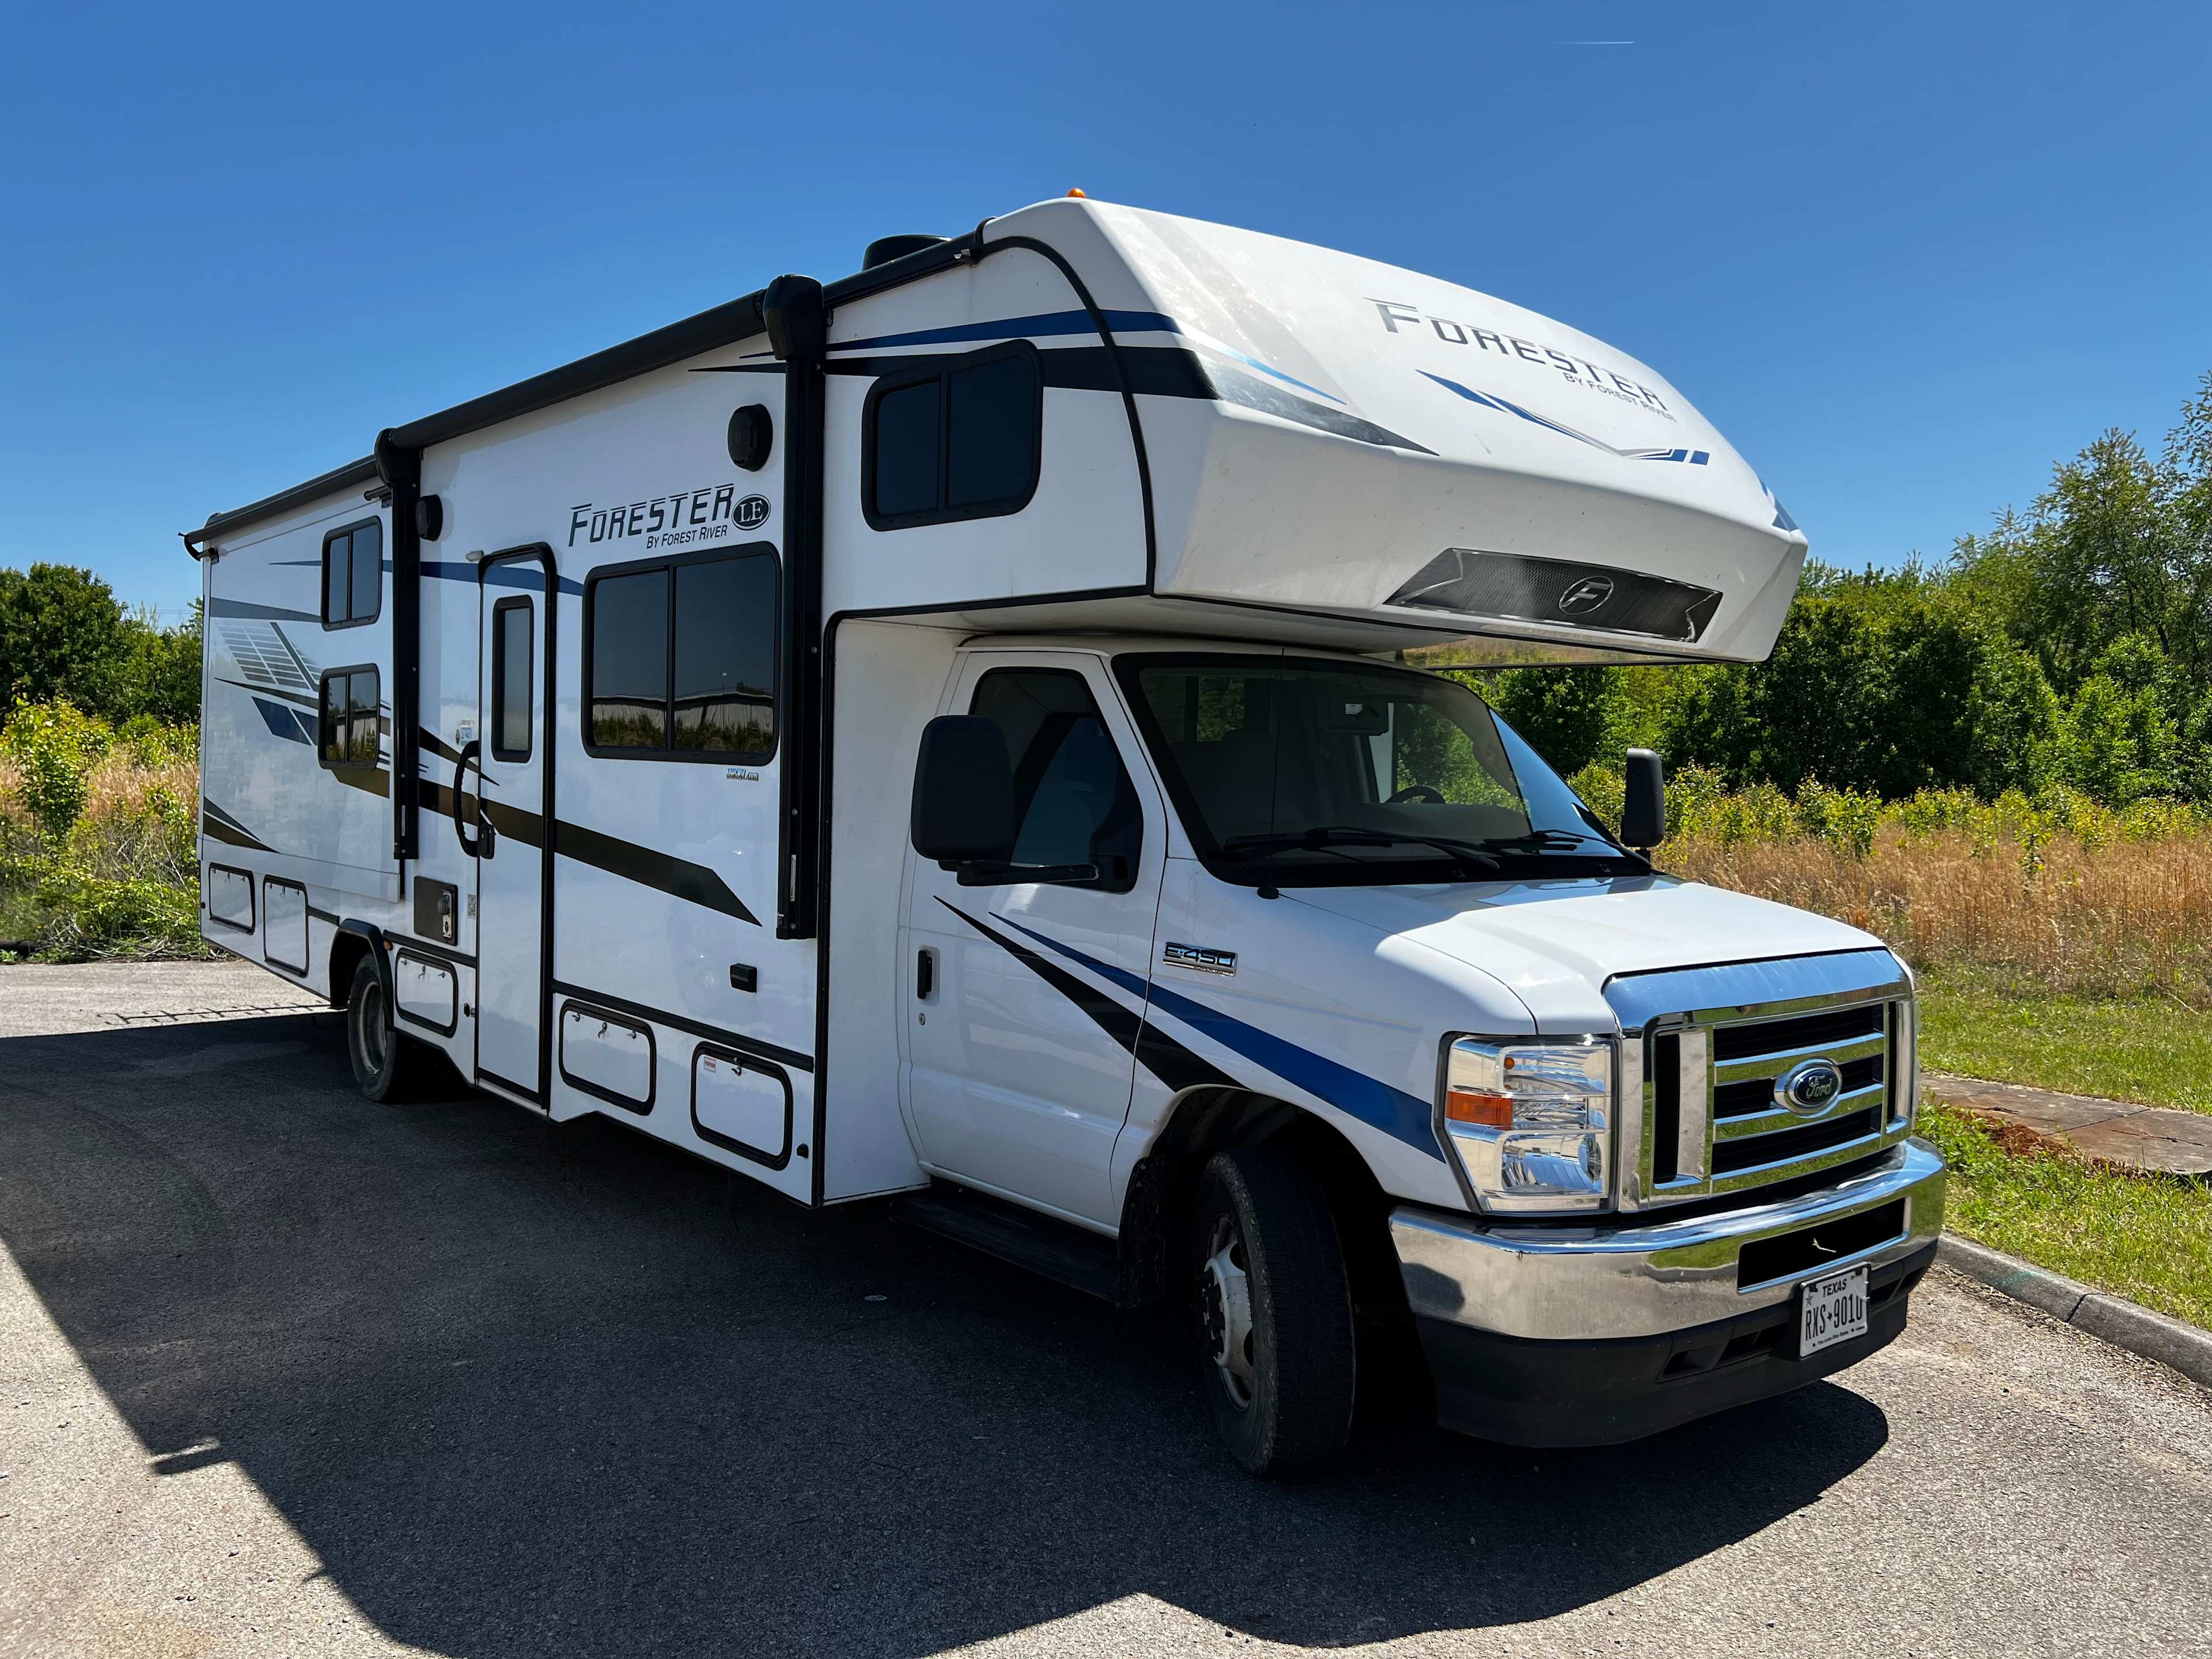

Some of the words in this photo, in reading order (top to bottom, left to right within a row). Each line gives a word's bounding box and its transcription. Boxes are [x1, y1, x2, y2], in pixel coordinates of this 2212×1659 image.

[1363, 297, 1668, 411] FORESTER
[1563, 372, 1583, 385] BY
[1586, 380, 1638, 405] FOREST
[569, 483, 734, 547] FORESTER
[737, 500, 764, 523] LE
[646, 536, 660, 549] BY
[661, 530, 698, 547] FOREST
[699, 525, 728, 540] RIVER
[1806, 1075, 1833, 1099] Ford
[1822, 1279, 1847, 1297] TEXAS
[1805, 1304, 1826, 1341] RXS
